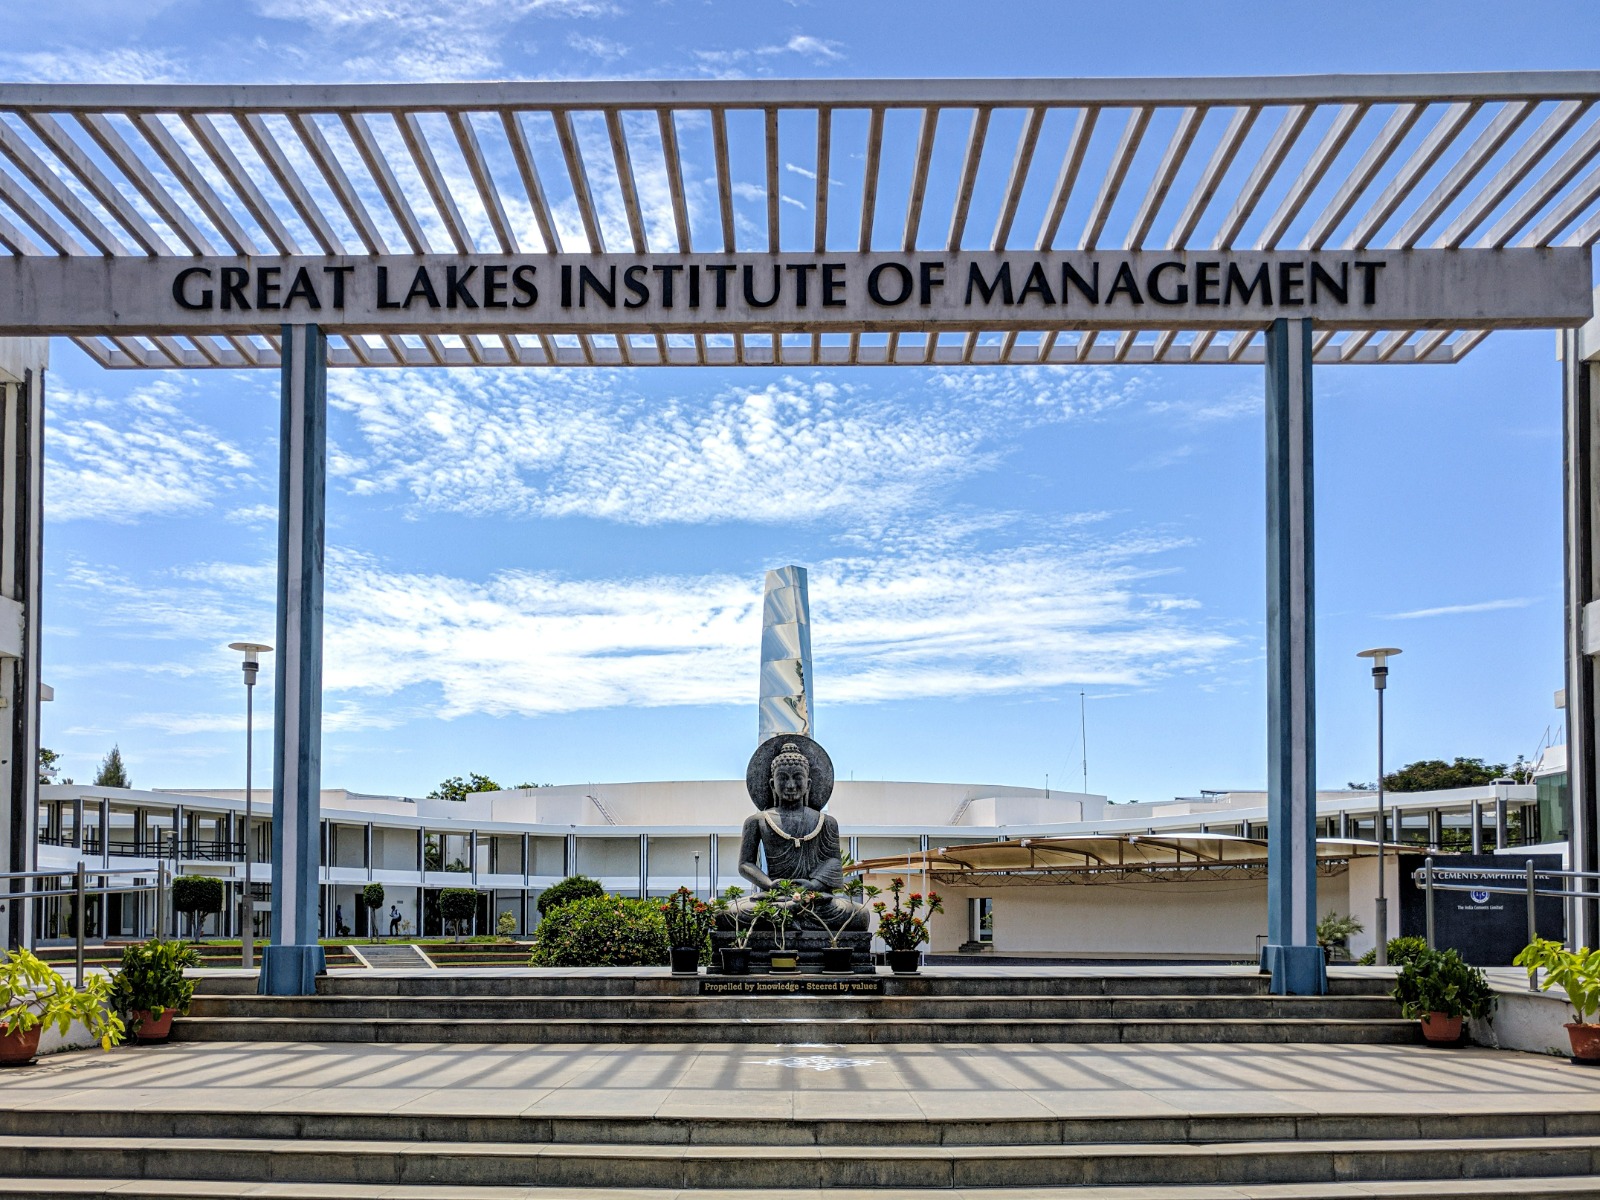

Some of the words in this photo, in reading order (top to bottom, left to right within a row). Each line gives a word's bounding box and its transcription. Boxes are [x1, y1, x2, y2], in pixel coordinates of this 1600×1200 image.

[172, 266, 355, 311] GREAT
[376, 265, 539, 310] LAKES
[560, 264, 847, 309] INSTITUTE
[867, 262, 945, 307] OF
[964, 261, 1387, 307] MANAGEMENT
[1438, 872, 1479, 880] CEMENTS
[704, 982, 743, 993] Propelled
[744, 982, 755, 992] by
[756, 982, 800, 992] knowledge
[806, 982, 838, 990] Steered
[839, 982, 850, 992] by
[851, 982, 878, 990] values
